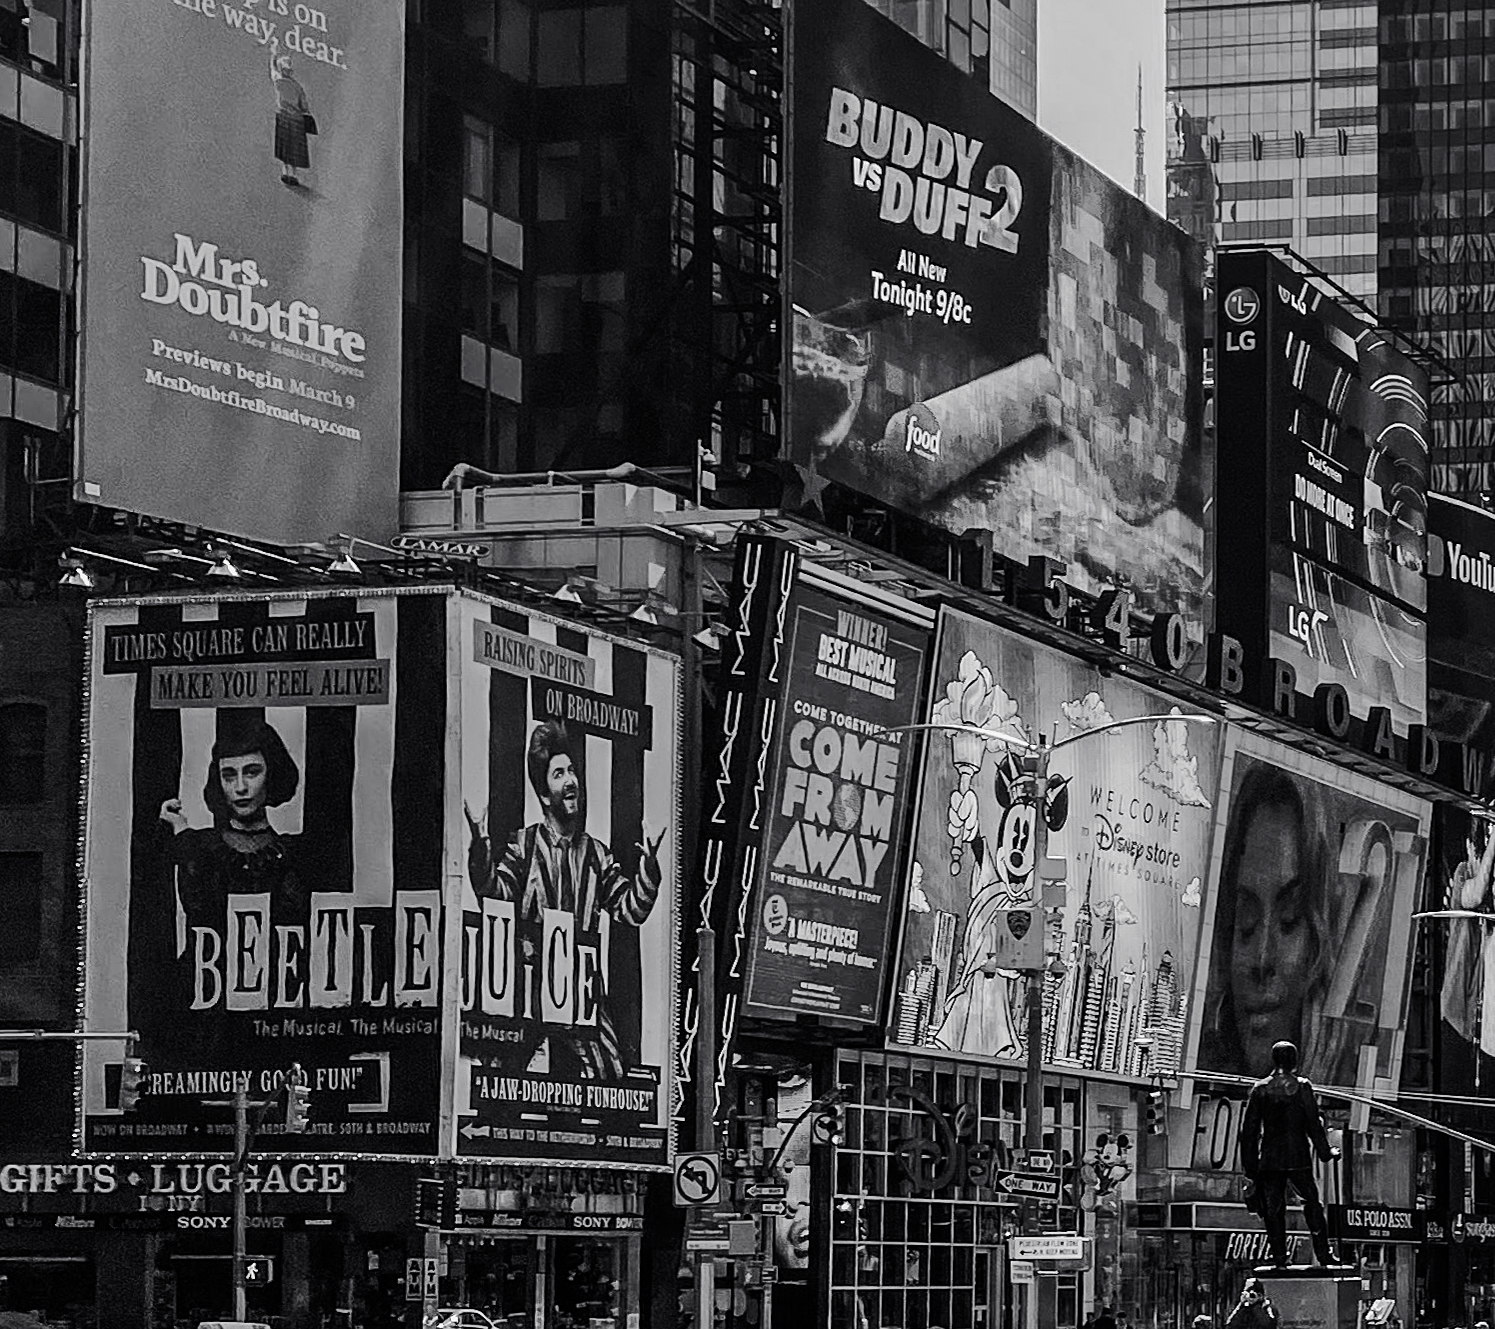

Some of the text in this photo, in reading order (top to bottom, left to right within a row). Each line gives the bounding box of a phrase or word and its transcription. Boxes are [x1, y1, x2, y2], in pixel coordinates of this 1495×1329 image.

[294, 3, 328, 33] on
[284, 24, 349, 70] dear.
[826, 86, 984, 190] BUDDY
[852, 156, 1023, 255] VS DUFF 2
[172, 232, 269, 290] Mrs.
[896, 248, 948, 284] All New
[140, 255, 366, 363] Doubtfire
[870, 269, 973, 325] Tonight 9/8c
[1225, 330, 1257, 352] LG
[152, 337, 356, 410] Previews begin March 9
[144, 367, 361, 442] MrsDoubtfireBroadway.com
[905, 414, 942, 456] food
[398, 535, 484, 557] LAMAR
[111, 620, 367, 663] TIMES SQUARE CAN REALLY
[1288, 604, 1311, 642] LG
[483, 630, 587, 687] RAISING SPIRITS
[817, 632, 850, 668] BEST
[847, 643, 897, 685] MUSICAL
[157, 666, 384, 701] MAKE YOU FEEL ALIVE!
[545, 687, 640, 737] ON BROADWAY!
[794, 699, 828, 722] COME
[888, 731, 904, 744] AT
[789, 719, 901, 793] COME
[780, 766, 895, 842] FROM
[1090, 783, 1181, 833] WELCOME
[772, 819, 890, 889] AWAY
[1145, 841, 1181, 869] store
[770, 871, 883, 905] THE REMARKABLE TRUE STORY
[190, 905, 436, 1012] BEETLE
[253, 1019, 280, 1037] The
[350, 1017, 378, 1036] The
[460, 1021, 481, 1039] The
[490, 1075, 583, 1107] JAW-DROPPING
[376, 1121, 432, 1136] BROADWAY
[0, 1163, 348, 1194] GIFTS LUGGAGE
[1004, 1177, 1053, 1193] ONE WAY
[167, 1194, 203, 1213] NY
[177, 1216, 232, 1229] SONY
[573, 1215, 611, 1229] SONY
[1346, 1209, 1364, 1227] U.S.
[1364, 1210, 1388, 1228] POLO
[425, 1259, 437, 1298] ATM
